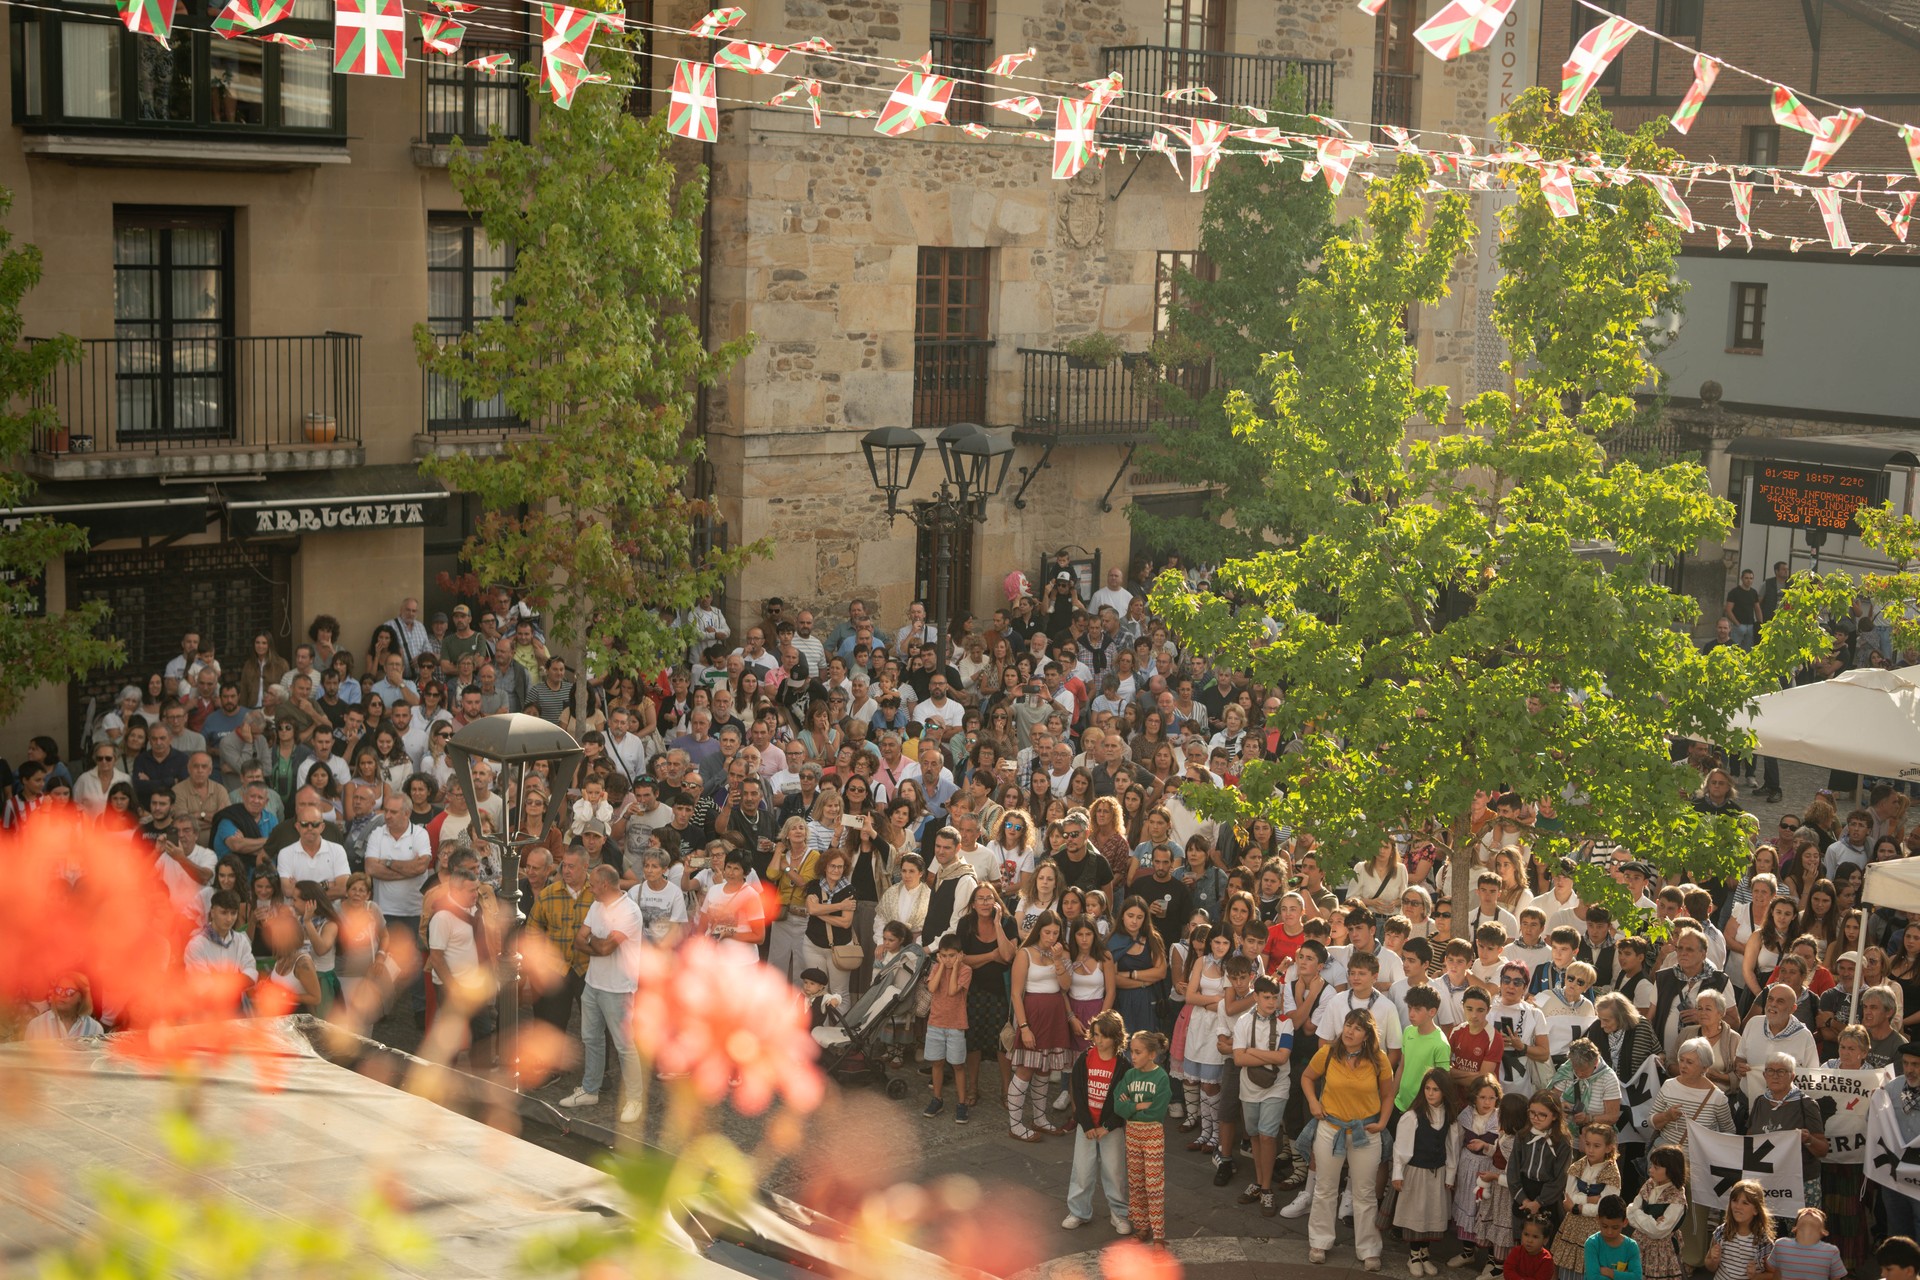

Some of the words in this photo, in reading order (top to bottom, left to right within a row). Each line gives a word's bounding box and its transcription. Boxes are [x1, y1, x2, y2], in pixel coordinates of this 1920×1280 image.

[1501, 11, 1517, 112] OROZK
[1765, 468, 1800, 480] 01/SEP
[1806, 473, 1835, 484] 18:57
[1766, 494, 1819, 508] 946339945
[1803, 489, 1868, 505] INFORMACION
[256, 503, 424, 532] ARRUGAETA
[1774, 503, 1792, 515] LOS
[1797, 506, 1850, 521] MIERCOLES
[1776, 512, 1800, 523] 9:30
[1804, 515, 1811, 525] A
[1817, 517, 1847, 529] 15:00
[1455, 1056, 1478, 1069] QATAR
[1793, 1074, 1816, 1083] KAL
[1821, 1075, 1862, 1087] PRESO
[1795, 1082, 1870, 1098] HESLARIAK
[1827, 1132, 1867, 1154] ERA
[1763, 1188, 1793, 1198] xera
